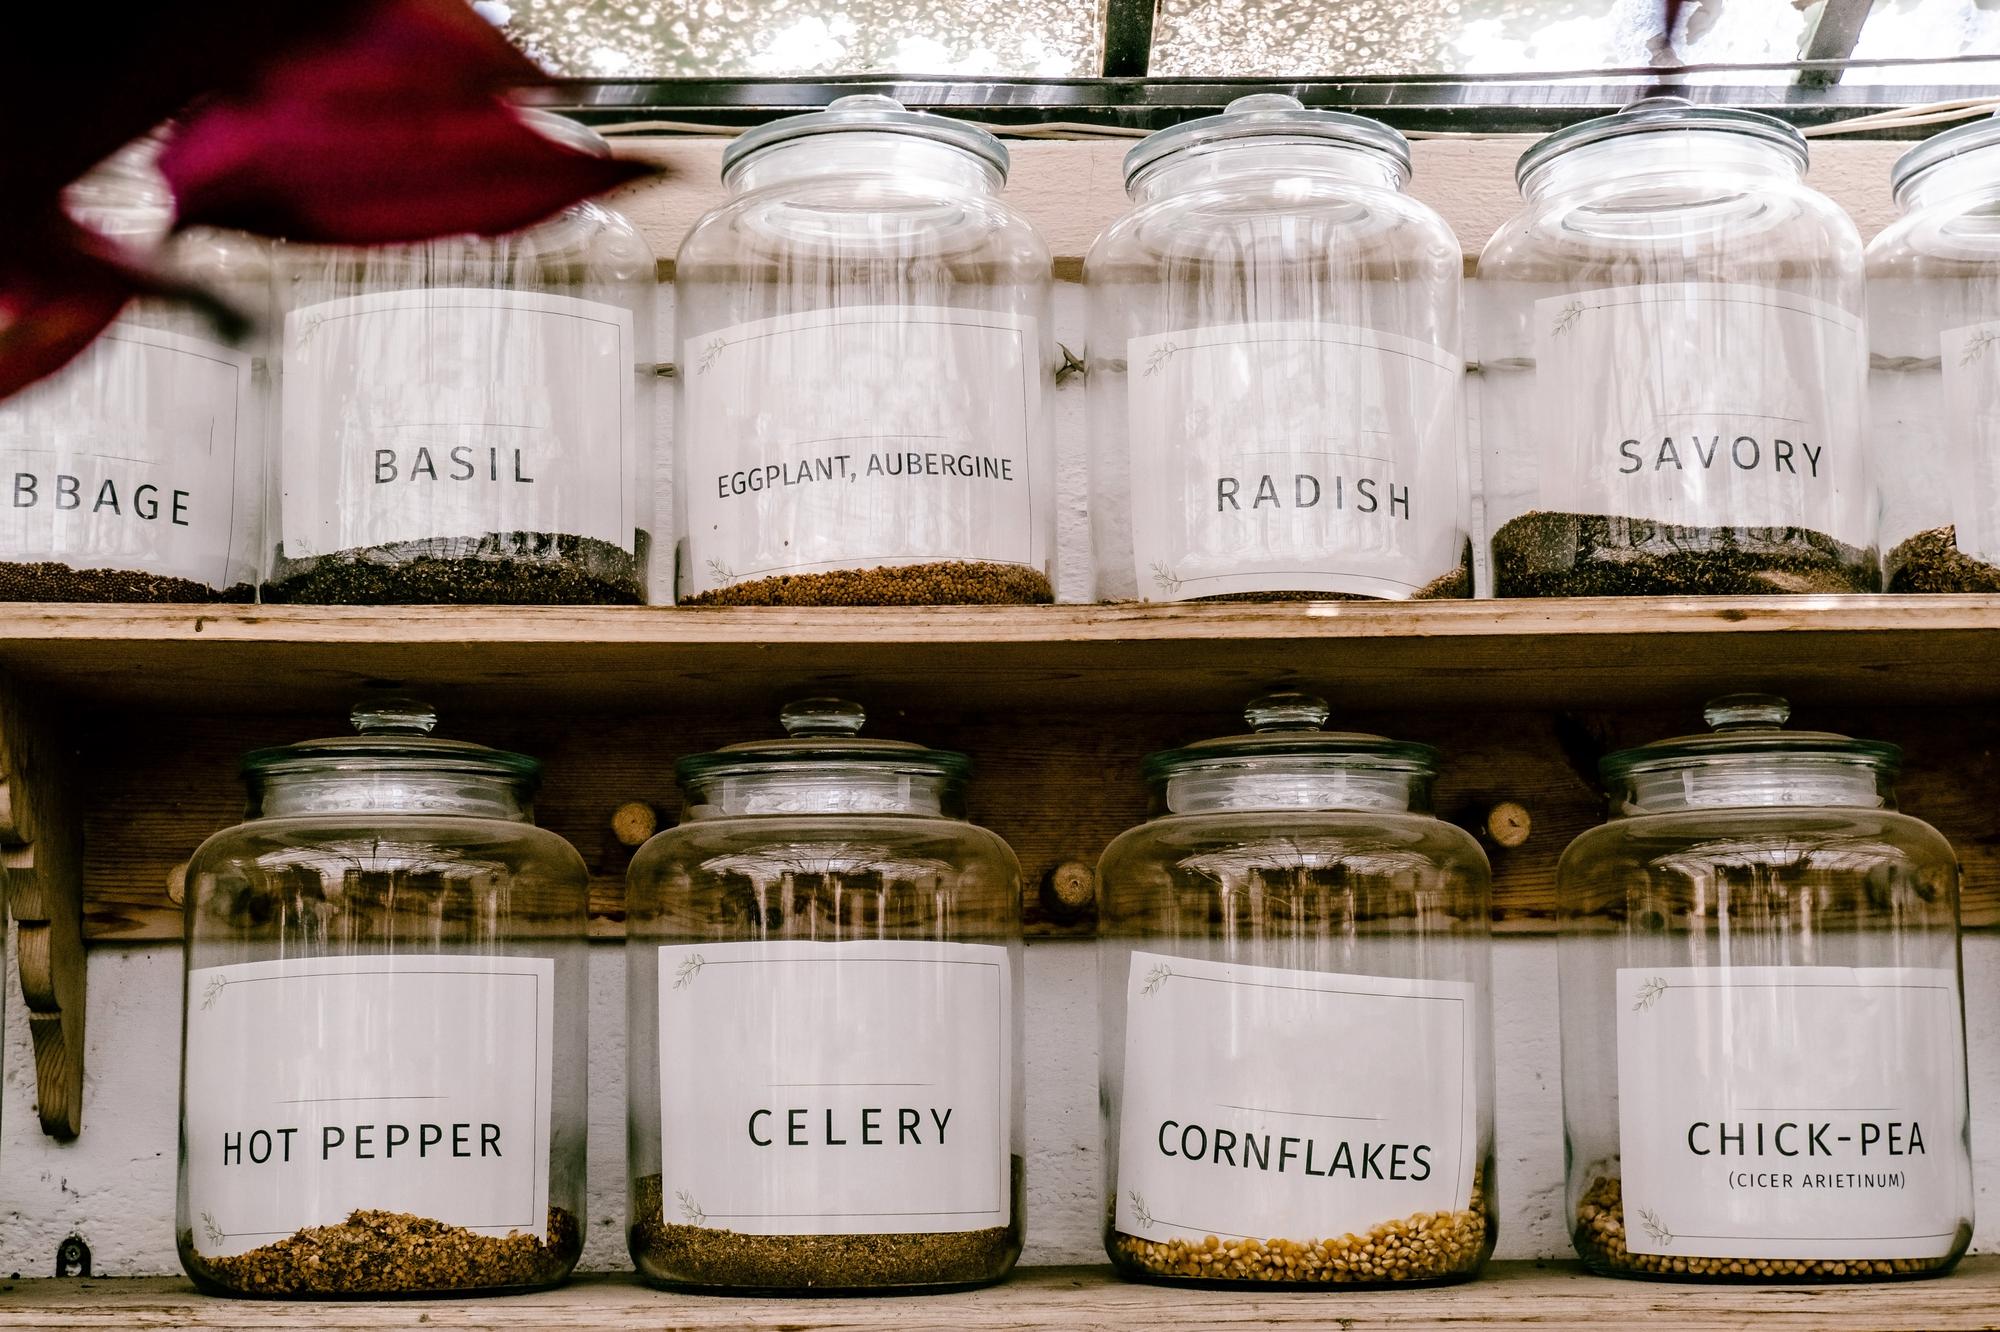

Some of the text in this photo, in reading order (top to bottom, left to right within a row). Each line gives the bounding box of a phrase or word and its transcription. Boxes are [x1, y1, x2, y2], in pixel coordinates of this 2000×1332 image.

[374, 445, 535, 485] BASIL
[717, 452, 1014, 500] EGGPLANT, AUBERGINE
[1618, 435, 1823, 479] SAVORY
[1217, 473, 1410, 521] RADISH
[223, 1122, 503, 1167] HOT PEPPER
[748, 1107, 953, 1147] CELERY
[1687, 1121, 1926, 1157] CHICK-PEA
[1158, 1119, 1432, 1182] CORNFLAKES
[1728, 1170, 1906, 1191] (CICER ARIETINUM)
